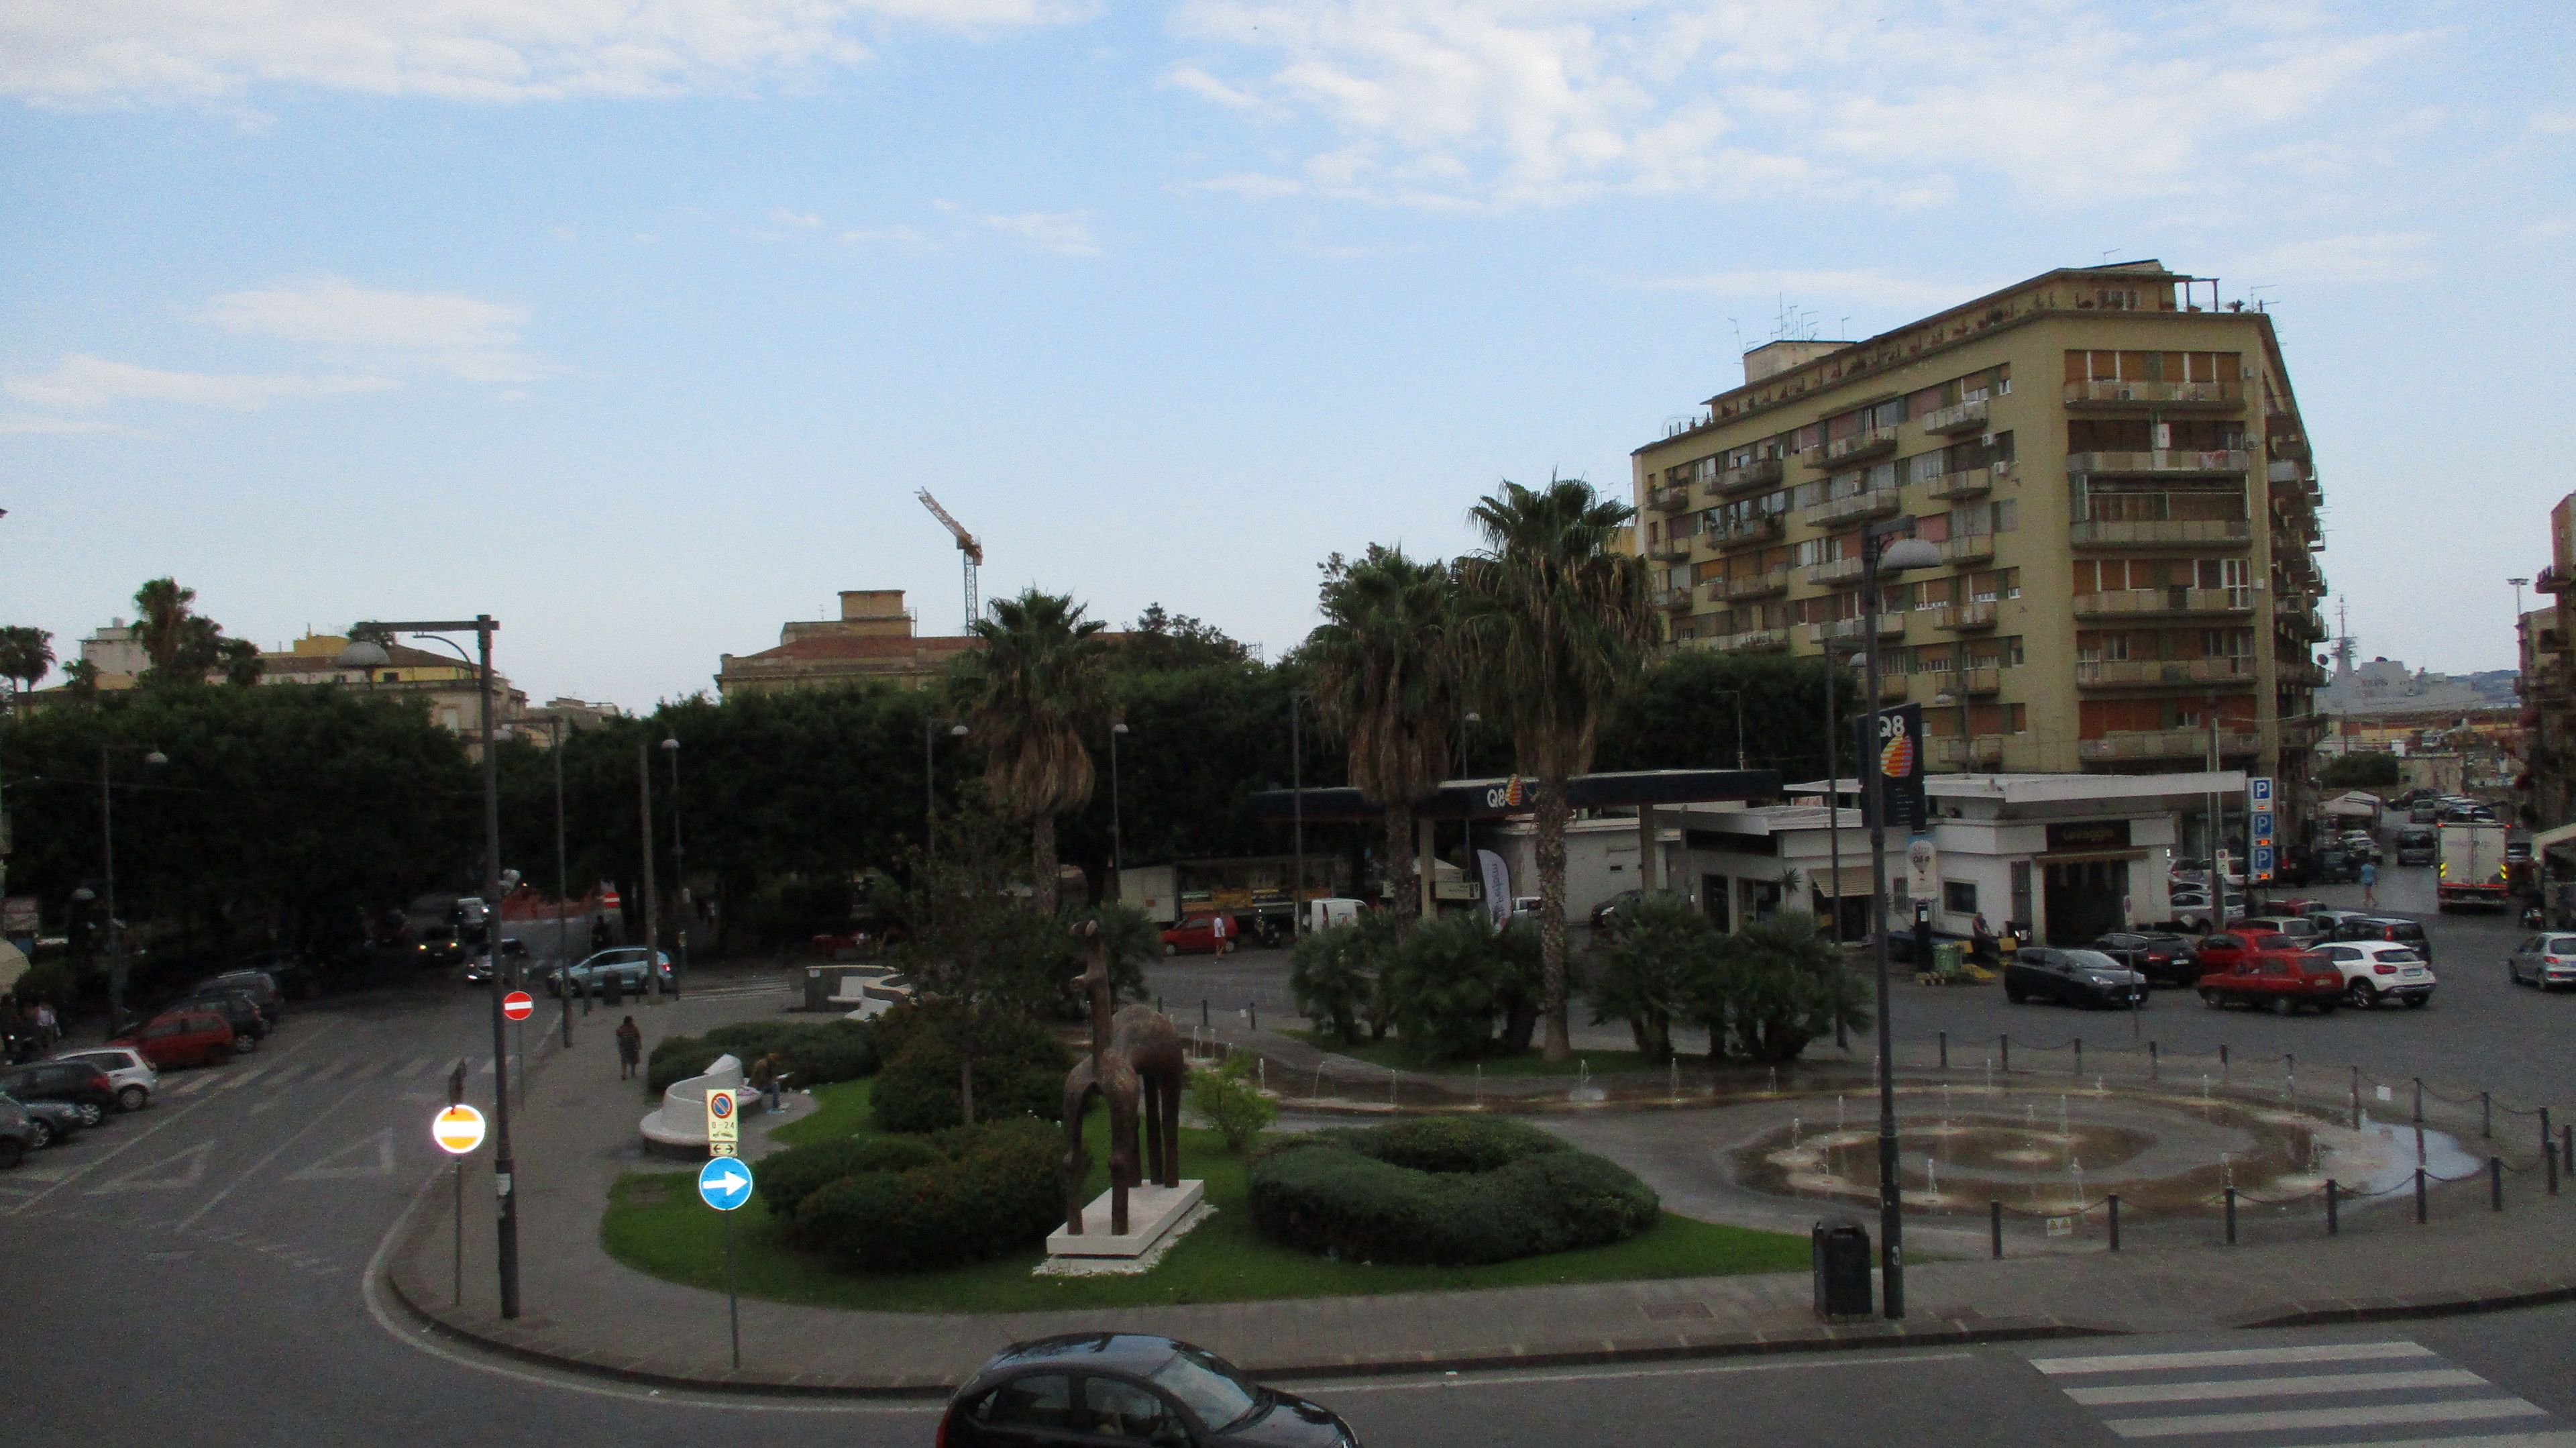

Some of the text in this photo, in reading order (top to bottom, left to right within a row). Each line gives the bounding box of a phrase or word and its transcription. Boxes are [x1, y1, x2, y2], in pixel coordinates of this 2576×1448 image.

[1879, 715, 1906, 737] Q8
[1487, 788, 1505, 808] Q8
[2257, 782, 2267, 798] P
[2257, 817, 2267, 833] P
[2257, 851, 2267, 867] P
